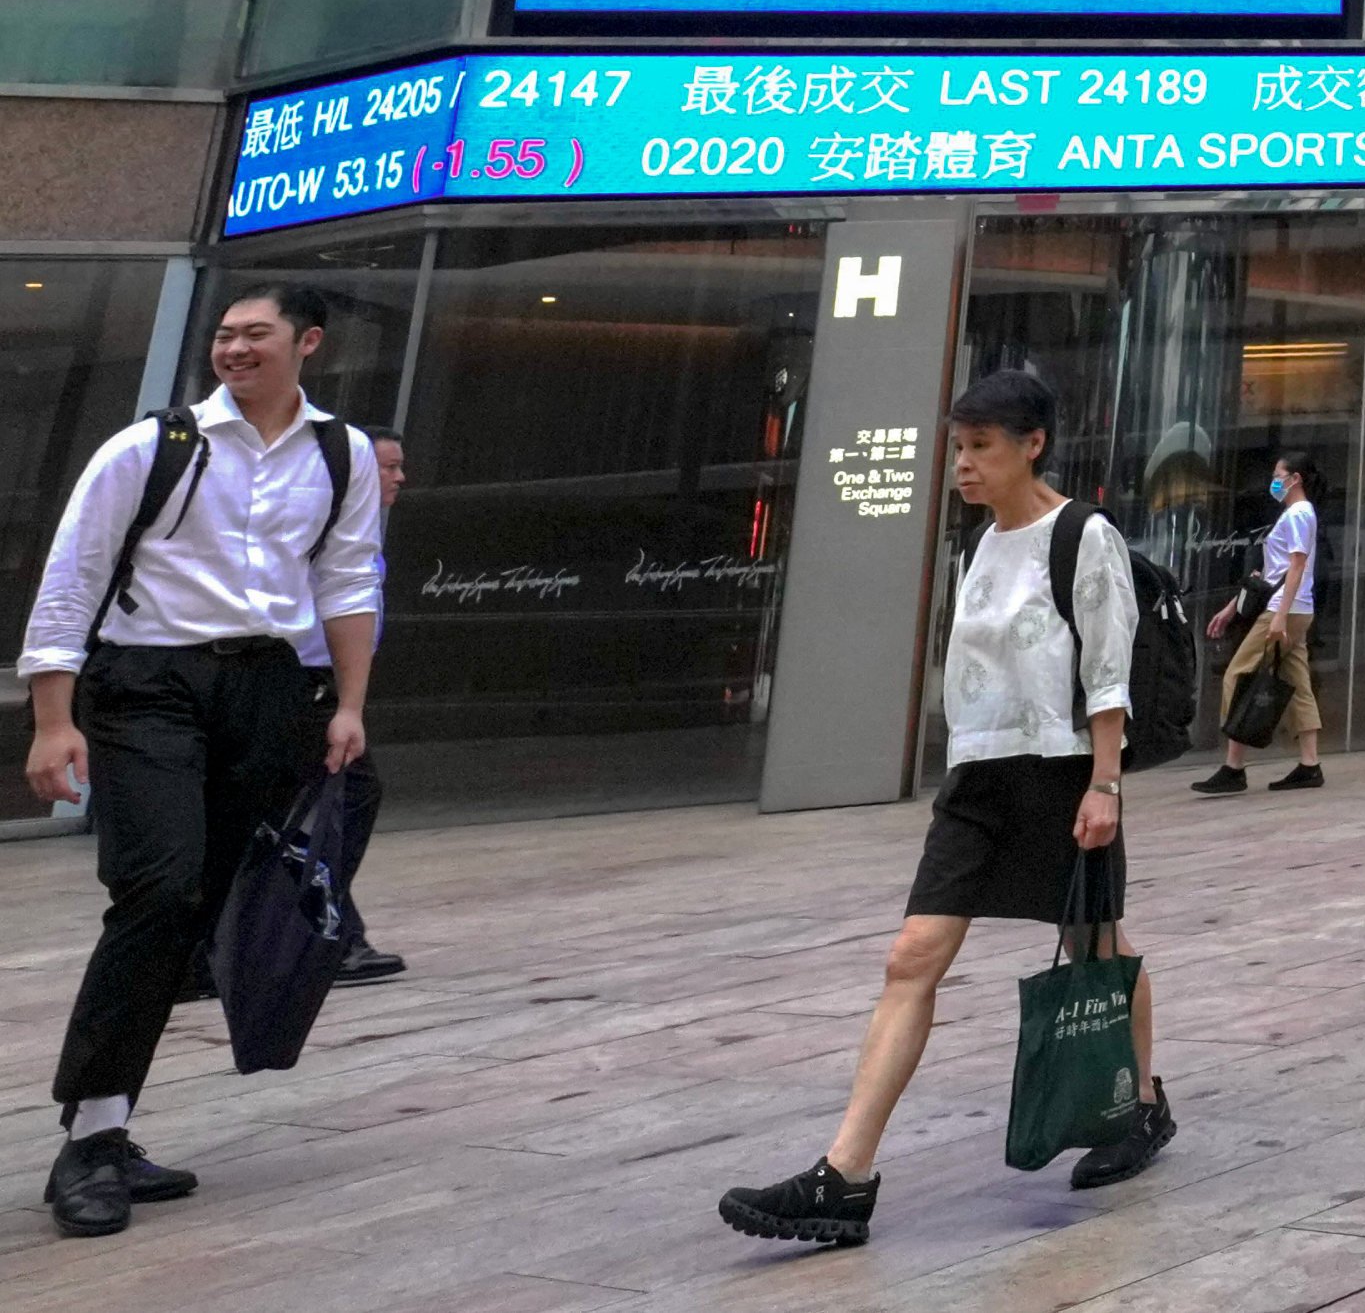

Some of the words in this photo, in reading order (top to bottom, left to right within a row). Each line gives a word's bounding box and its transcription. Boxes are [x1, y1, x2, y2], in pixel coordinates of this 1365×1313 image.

[241, 99, 304, 159] 最低
[312, 95, 353, 137] H/L
[362, 76, 444, 127] 24205
[479, 69, 633, 110] 24147
[680, 65, 915, 117] 最後成交
[939, 69, 1061, 106] LAST
[1078, 68, 1208, 106] 24189
[332, 150, 405, 199] 53.15
[640, 135, 785, 177] 02020
[807, 130, 1037, 183] 安踏體育
[1057, 133, 1185, 170] ANTA
[833, 255, 902, 318] H
[833, 470, 866, 486] One
[867, 469, 881, 484] &
[883, 468, 915, 484] Two
[840, 485, 913, 501] Exchange
[858, 501, 911, 518] Square
